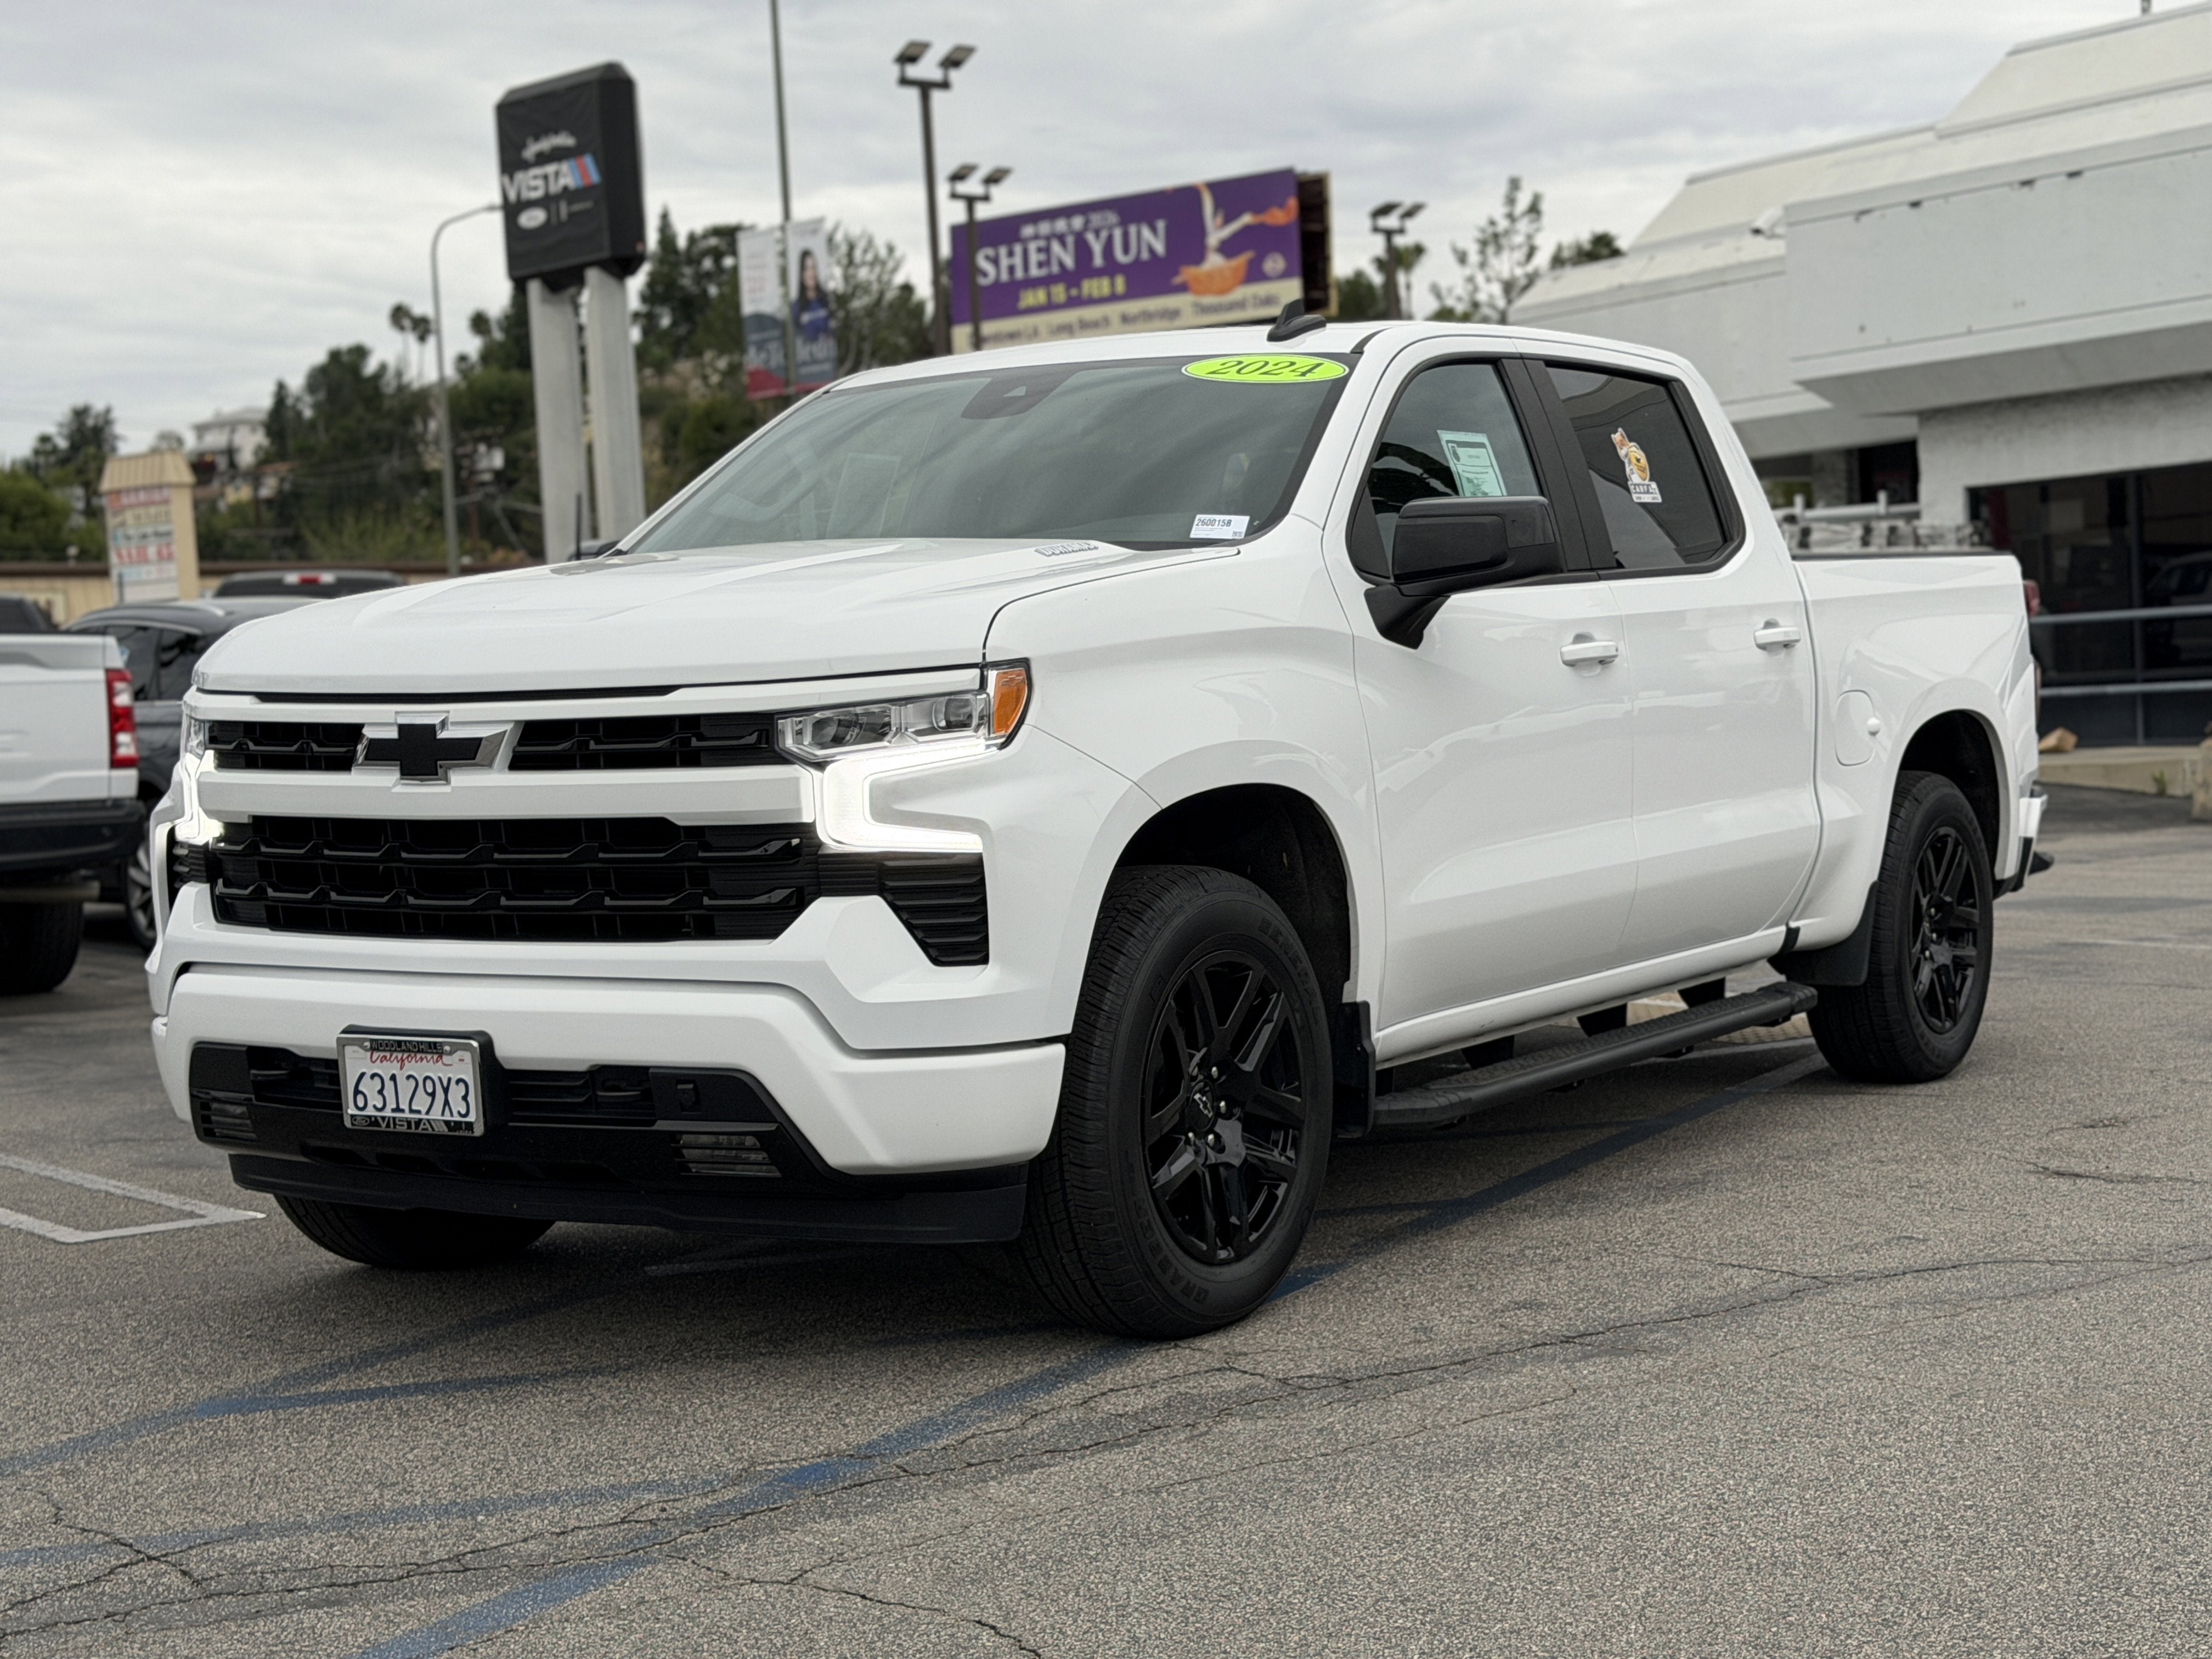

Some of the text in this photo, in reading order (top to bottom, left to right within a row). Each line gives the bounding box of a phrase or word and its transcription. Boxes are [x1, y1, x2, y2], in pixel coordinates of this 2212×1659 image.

[501, 159, 576, 204] VISTA
[975, 235, 1075, 286] SHEN
[1085, 220, 1167, 268] YUN
[1018, 285, 1048, 310] JAN
[1205, 360, 1325, 377] 2024
[1195, 518, 1233, 527] 260015B
[371, 1041, 443, 1053] WOODLAND HILLS
[370, 1050, 453, 1071] California
[353, 1071, 470, 1118] 63129X3
[377, 1117, 432, 1131] VISTA
